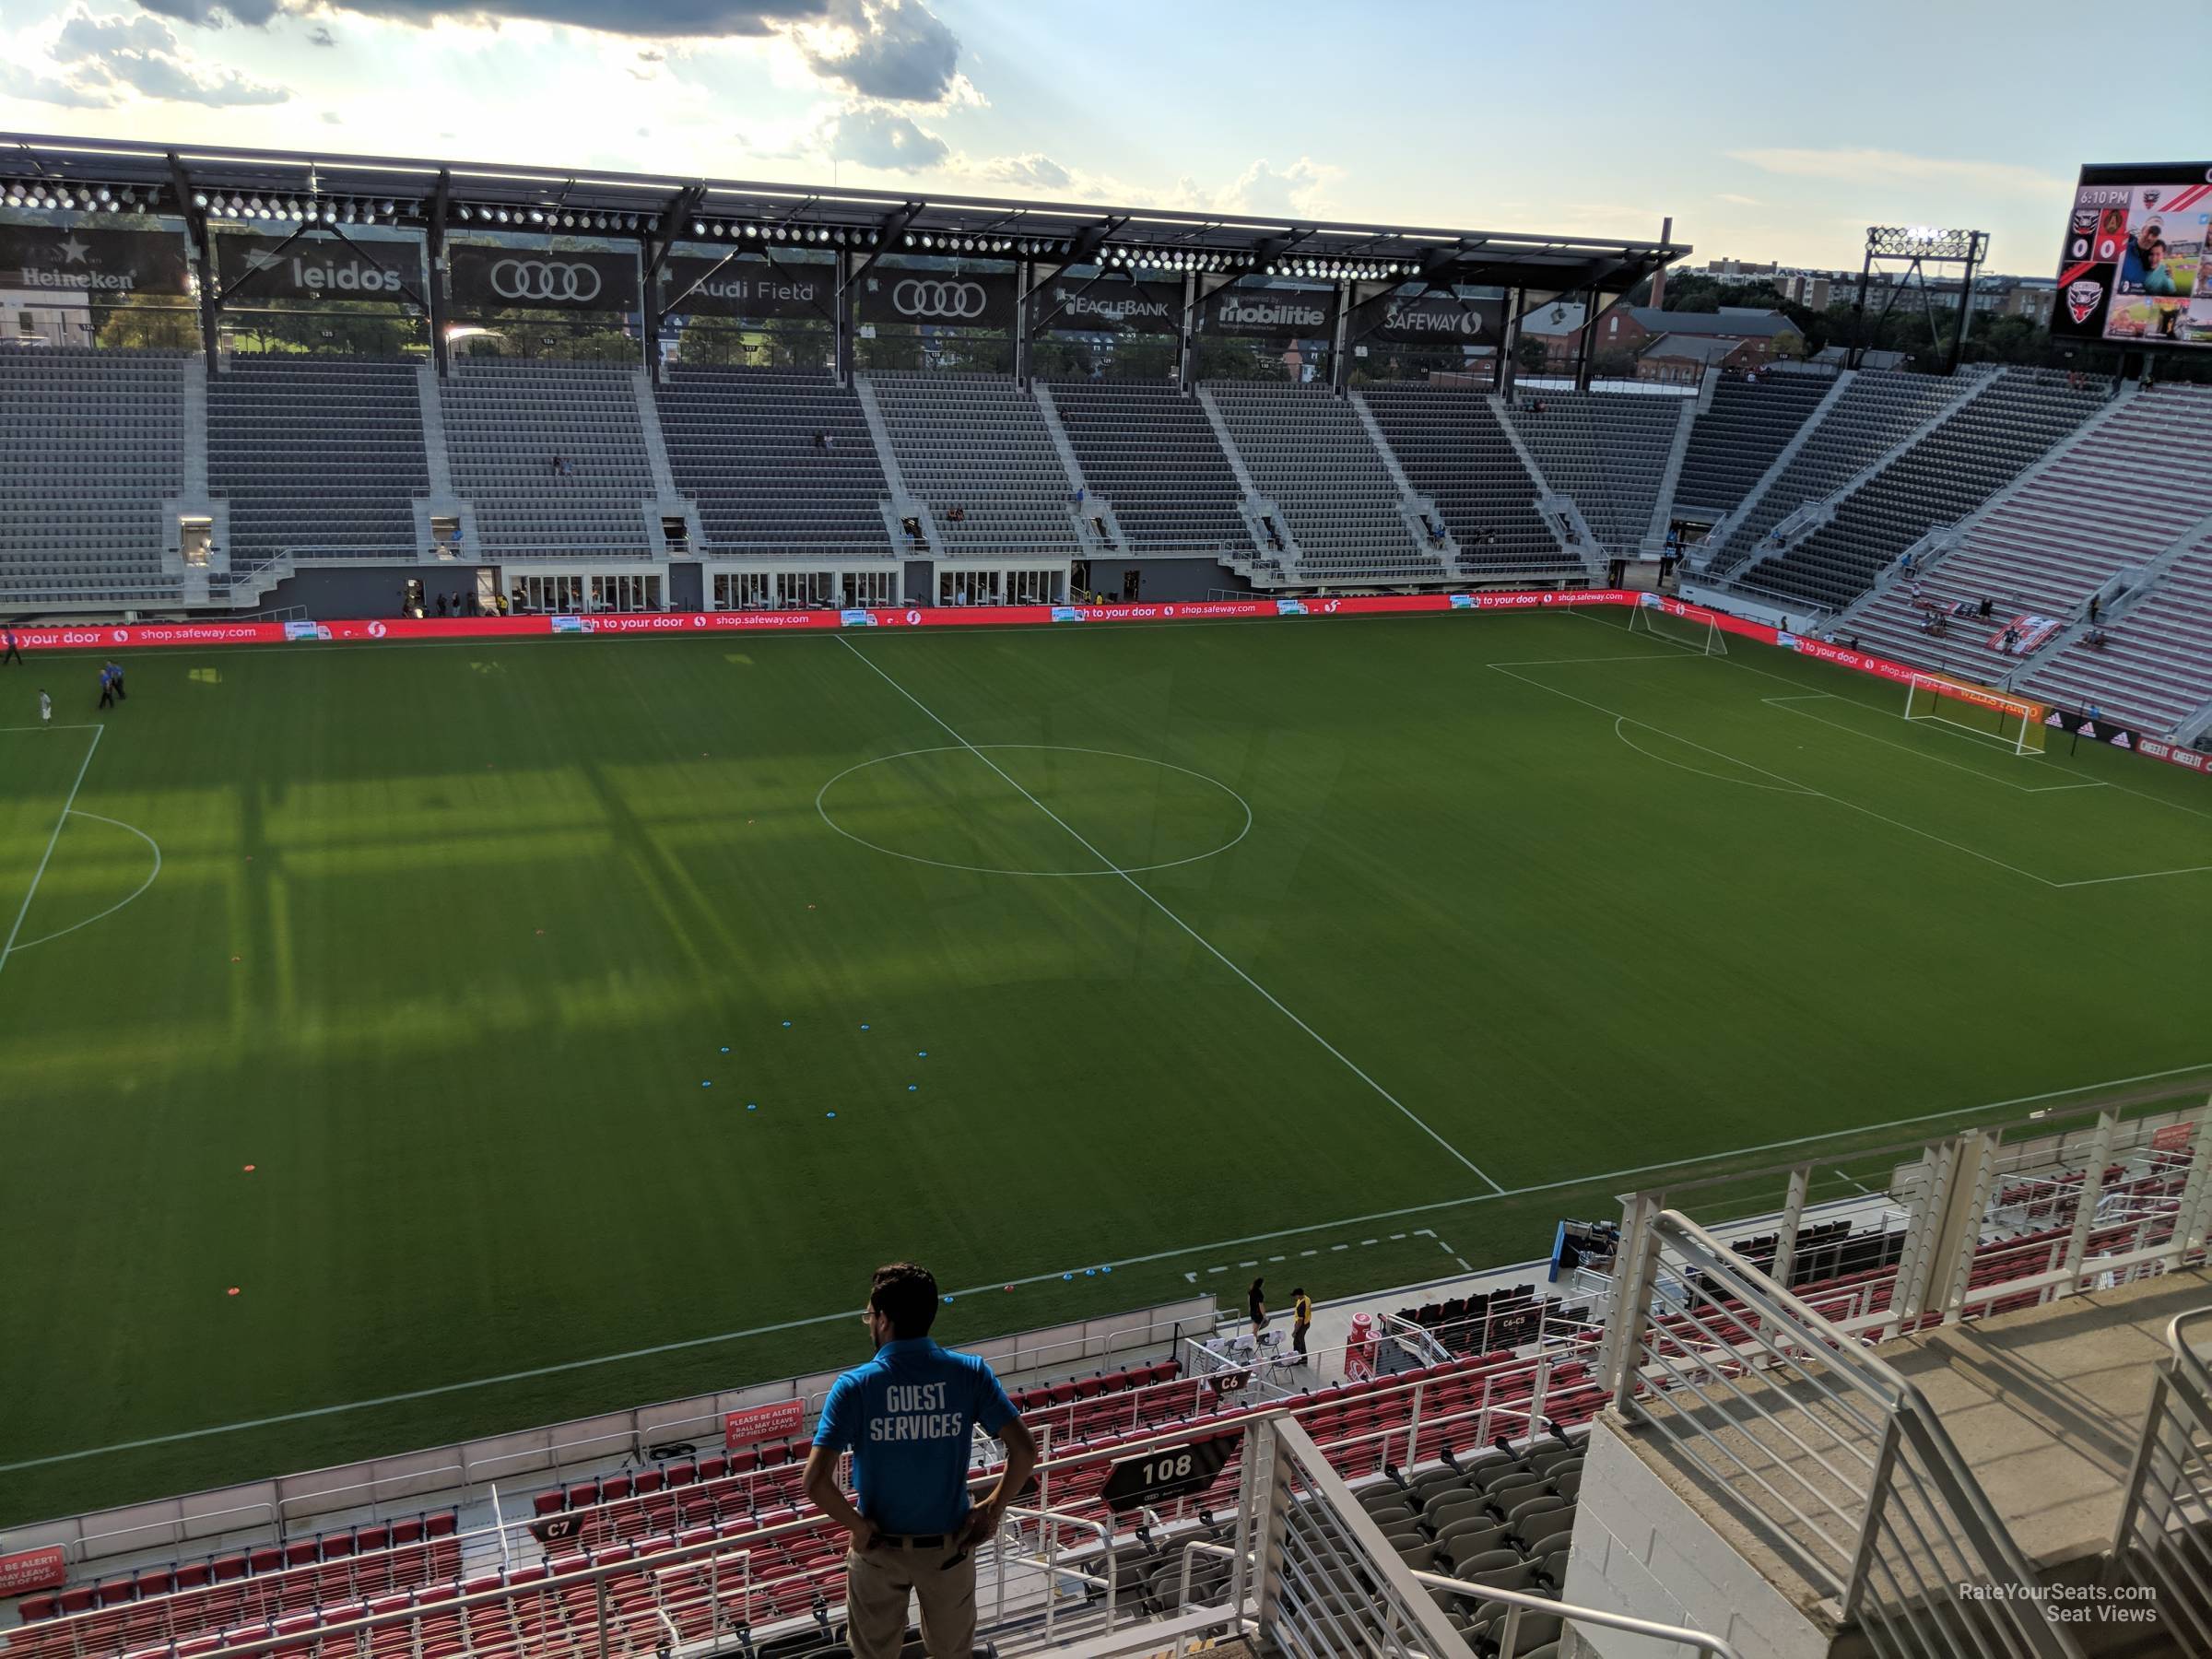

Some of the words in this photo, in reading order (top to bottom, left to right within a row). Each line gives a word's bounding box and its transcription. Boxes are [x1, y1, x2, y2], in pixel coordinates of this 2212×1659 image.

[2080, 191, 2106, 204] 6:10
[2108, 191, 2129, 204] PM
[2072, 239, 2088, 258] 0
[2100, 240, 2115, 258] 0
[21, 267, 135, 289] Heineken
[294, 258, 401, 291] leidos
[689, 278, 747, 298] Audi
[758, 281, 814, 300] Field
[1219, 304, 1325, 325] mobilitie
[1384, 312, 1460, 332] SAFEWAY
[1483, 596, 1492, 605] to
[1494, 597, 1514, 607] your
[1516, 595, 1537, 604] door
[1106, 608, 1130, 618] your
[1132, 606, 1157, 616] door
[1182, 605, 1255, 616] shop.safeway.com
[621, 618, 651, 630] your
[653, 617, 684, 628] door
[716, 615, 809, 627] shop.safeway.com
[22, 635, 58, 647] your
[63, 631, 100, 643] door
[141, 628, 256, 641] shop.safeway.com
[1806, 642, 1816, 653] to
[1816, 646, 1836, 658] your
[1837, 649, 1859, 665] door
[1221, 1375, 1239, 1390] C6
[887, 1382, 947, 1413] GUEST
[729, 1415, 759, 1427] PLEASE
[772, 1406, 800, 1418] ALERT!
[735, 1425, 754, 1433] BALL
[755, 1421, 771, 1430] MAY
[772, 1417, 794, 1426] LEAVE
[870, 1412, 963, 1441] SERVICES
[731, 1431, 746, 1441] THE
[747, 1428, 767, 1437] FIELD
[1143, 1454, 1192, 1485] 108
[547, 1521, 570, 1536] C7
[5, 1562, 18, 1571] BE
[21, 1555, 58, 1569] ALERT!
[21, 1567, 51, 1578] LEAVE
